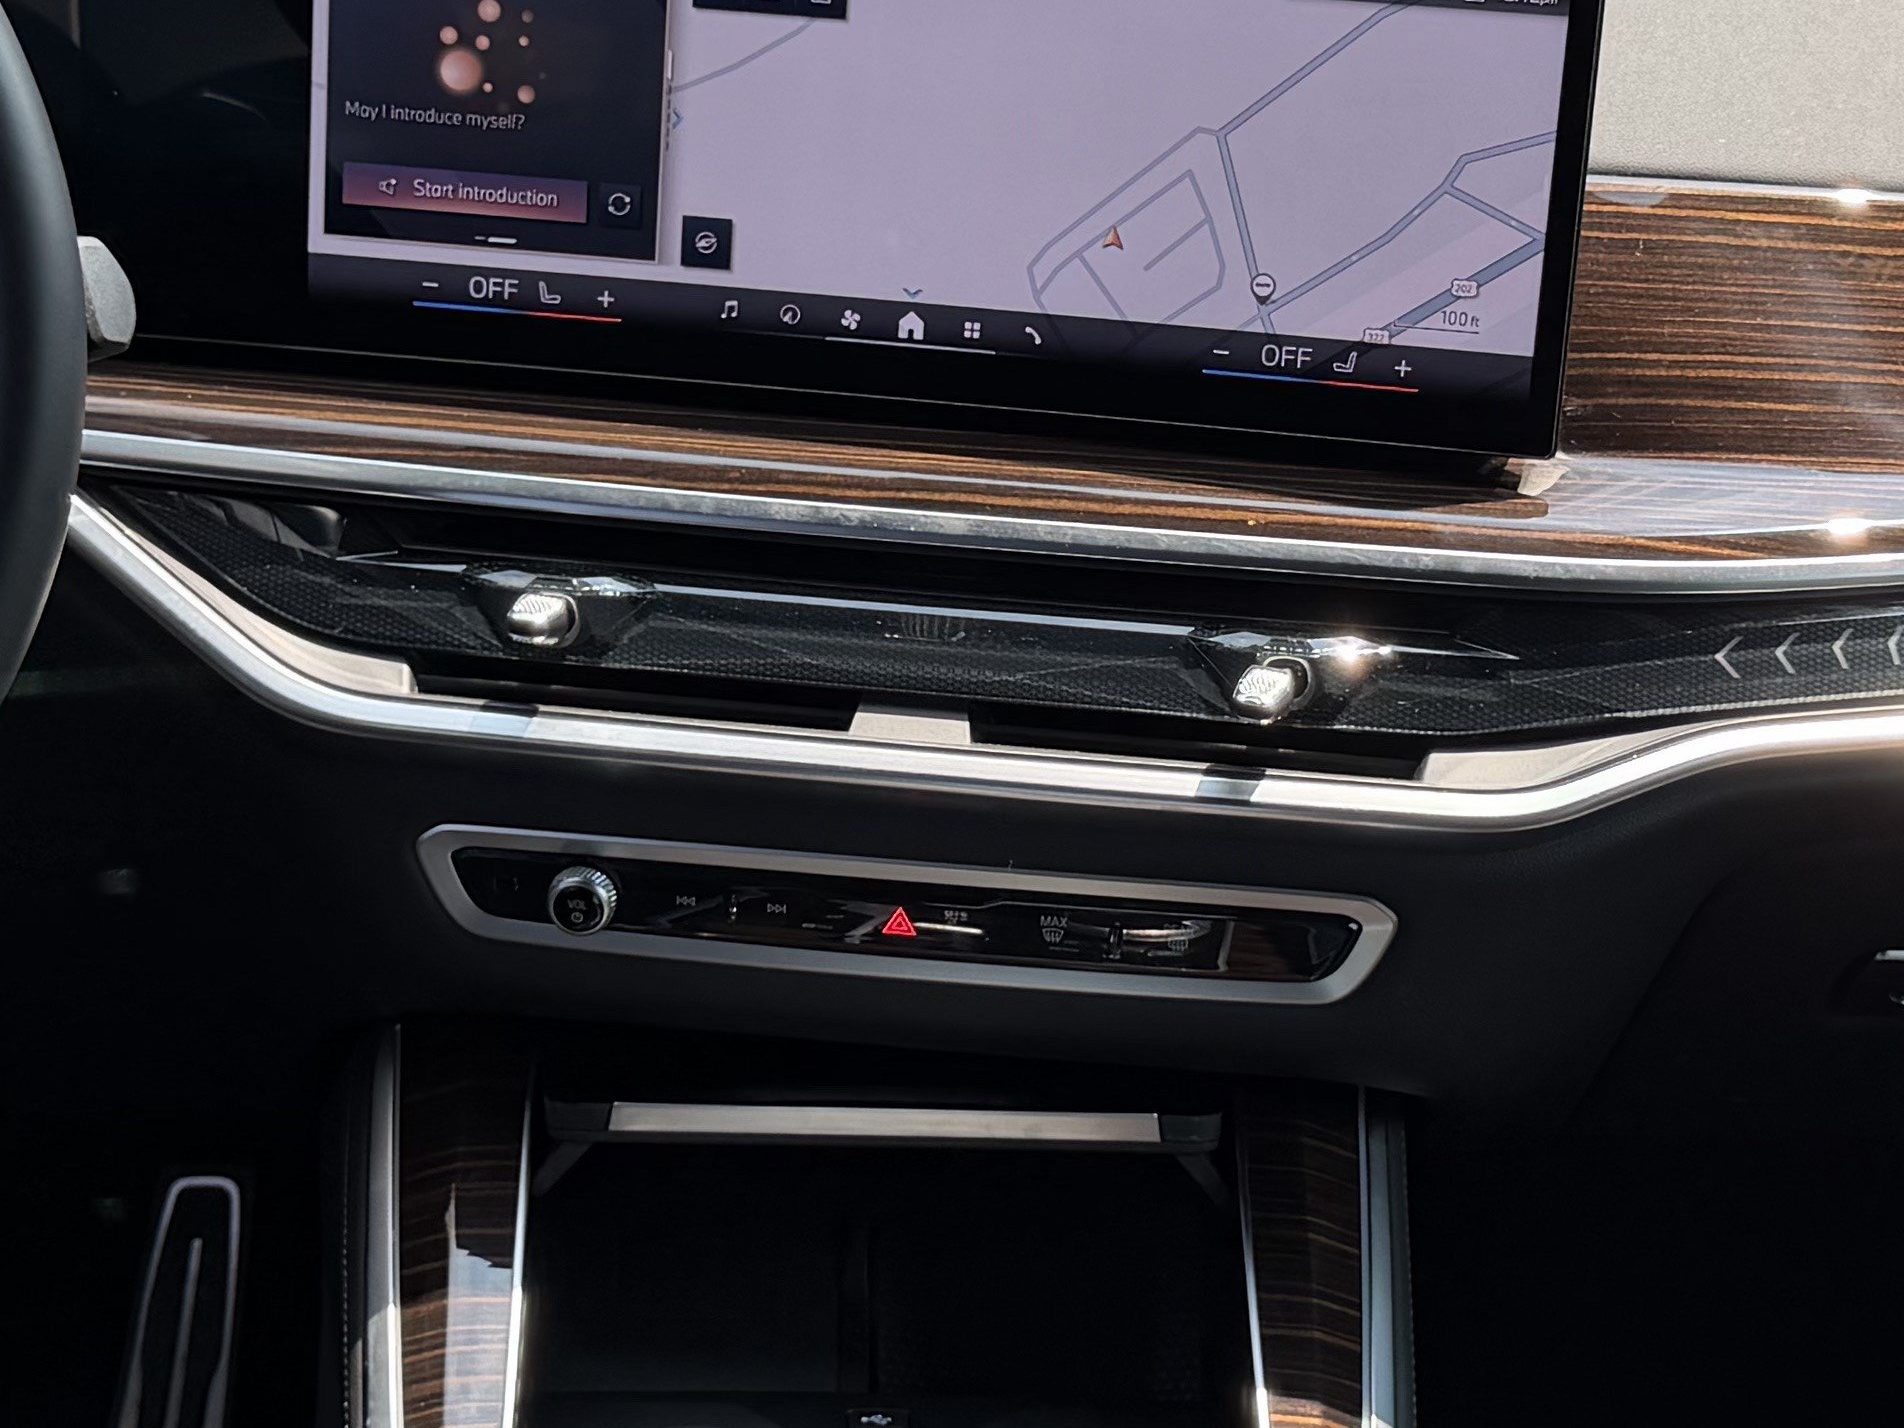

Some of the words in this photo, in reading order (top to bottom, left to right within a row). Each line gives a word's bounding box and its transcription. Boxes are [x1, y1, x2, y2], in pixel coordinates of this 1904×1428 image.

[345, 100, 379, 121] May
[382, 104, 388, 119] I
[391, 104, 463, 126] introduce
[466, 113, 526, 131] myself?
[413, 179, 454, 199] Start
[458, 183, 559, 208] introduction
[468, 275, 520, 300] OFF
[1454, 282, 1474, 294] 202
[1440, 310, 1467, 327] 100
[1470, 317, 1481, 328] ft
[1261, 344, 1314, 369] OFF
[567, 899, 586, 911] VOL
[1039, 915, 1068, 927] MAX
